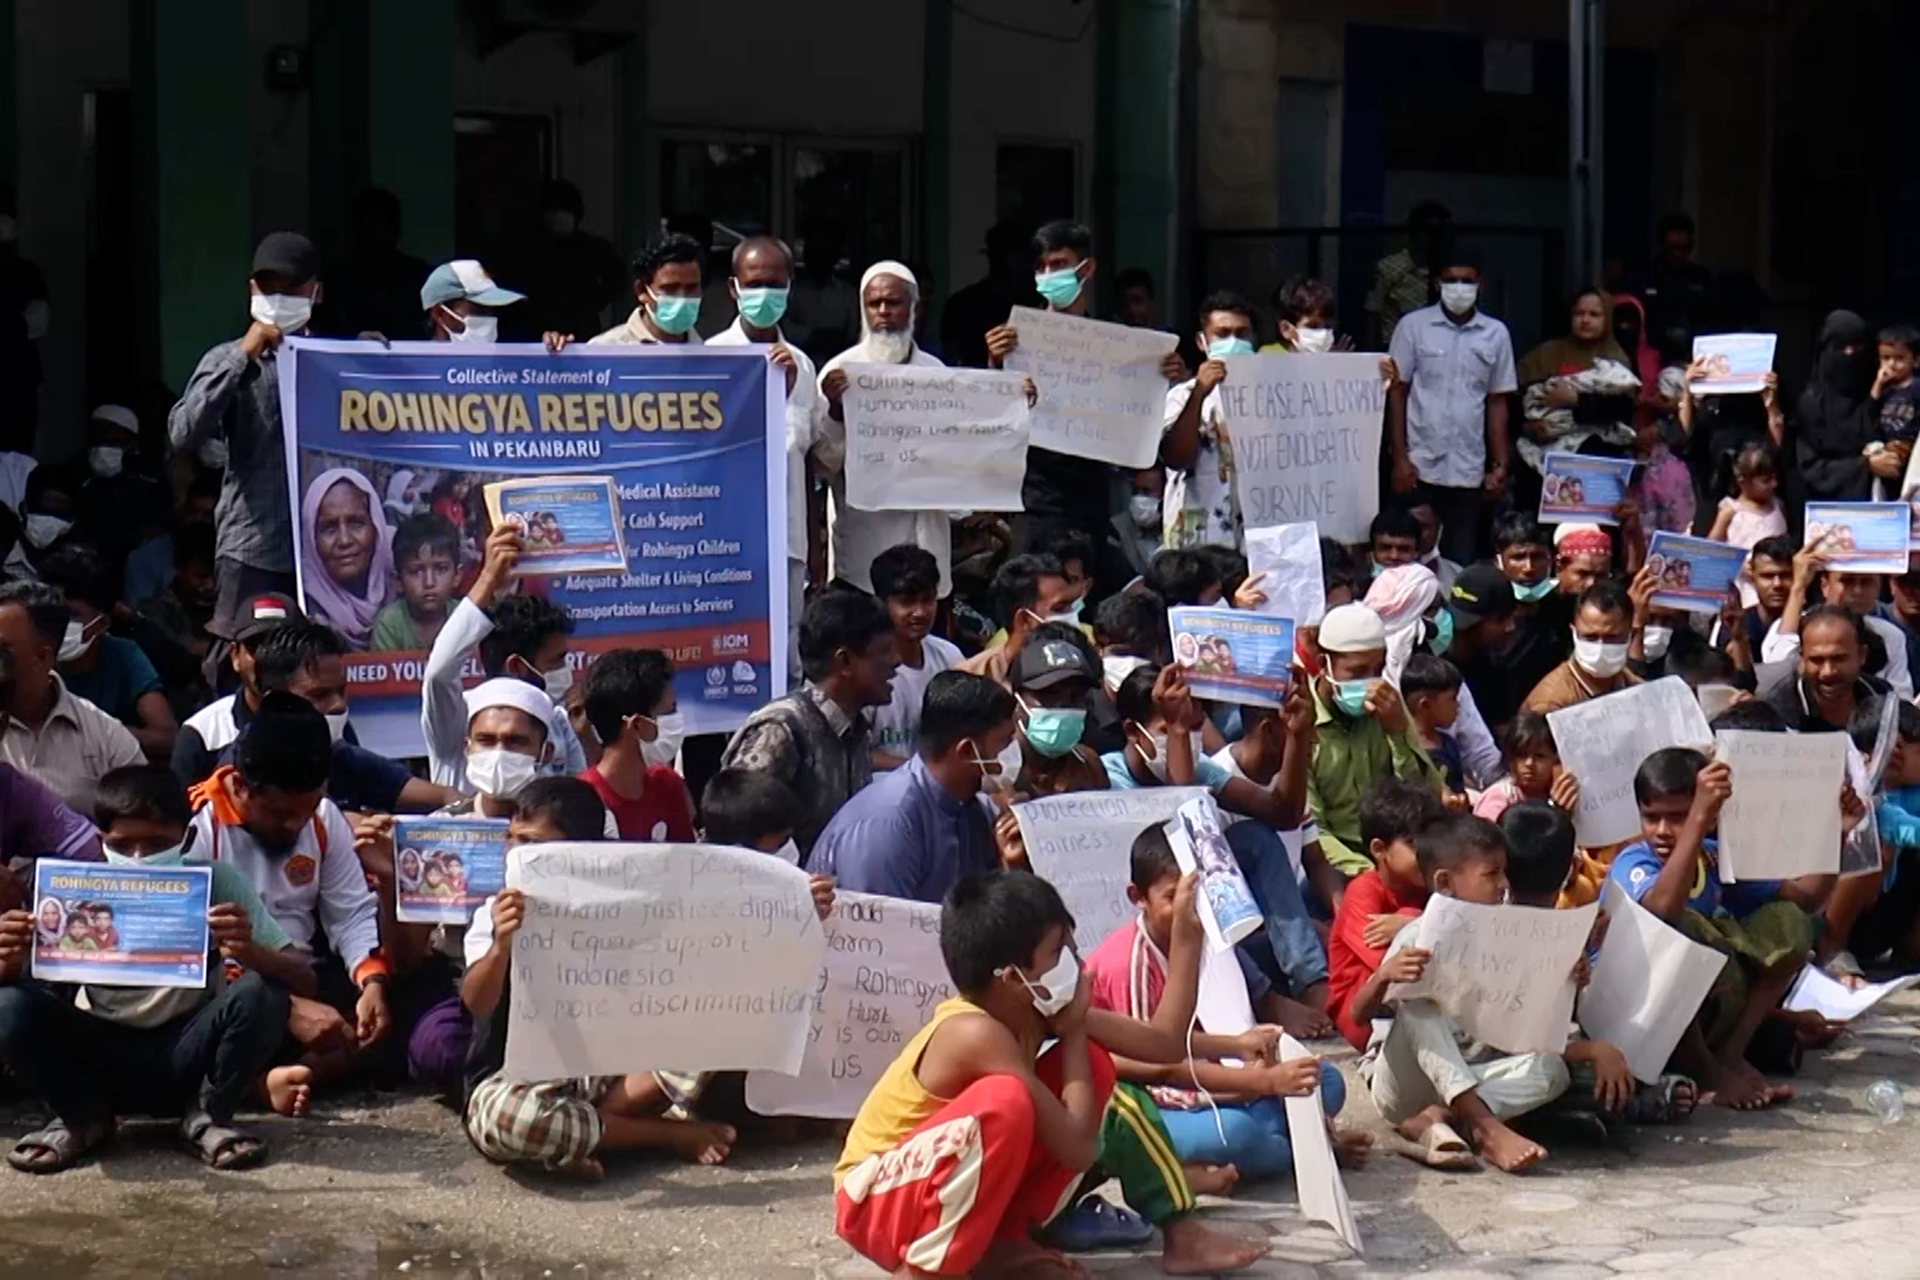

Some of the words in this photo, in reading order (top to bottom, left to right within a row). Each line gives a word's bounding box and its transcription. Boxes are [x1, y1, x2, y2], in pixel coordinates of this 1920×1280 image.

[447, 368, 518, 385] Collective
[521, 369, 593, 385] Statement
[596, 368, 612, 386] of
[857, 373, 916, 394] Cutting
[1220, 384, 1250, 418] THE
[1255, 382, 1297, 419] CASE
[340, 391, 532, 433] ROHINGYA
[539, 391, 724, 432] REFUGEES
[857, 421, 922, 442] Rohingya
[470, 441, 489, 458] IN
[494, 440, 602, 459] PEKANBARU
[1236, 433, 1271, 470] NOT
[1276, 430, 1339, 470] ENOUGH
[663, 484, 720, 498] Assistance
[1250, 480, 1336, 523] SURVIVE
[630, 512, 656, 529] Cash
[659, 512, 704, 531] Support
[642, 540, 695, 559] Rohingya
[698, 539, 741, 553] Children
[565, 574, 618, 591] Adequate
[621, 573, 662, 588] Shelter
[663, 572, 671, 583] &
[673, 570, 703, 587] Living
[704, 569, 753, 584] Conditions
[649, 602, 681, 615] Access
[683, 603, 692, 613] to
[693, 598, 734, 613] Services
[723, 634, 748, 648] IOM
[347, 664, 387, 682] NEED
[392, 660, 426, 682] YOU
[676, 646, 702, 661] LIFE!
[50, 875, 119, 891] ROHINGYA
[120, 880, 190, 894] REFUGEES
[523, 897, 621, 920] Demand
[520, 930, 554, 951] and
[519, 966, 533, 983] in
[855, 966, 949, 1009] Rohingya
[836, 1021, 853, 1043] is
